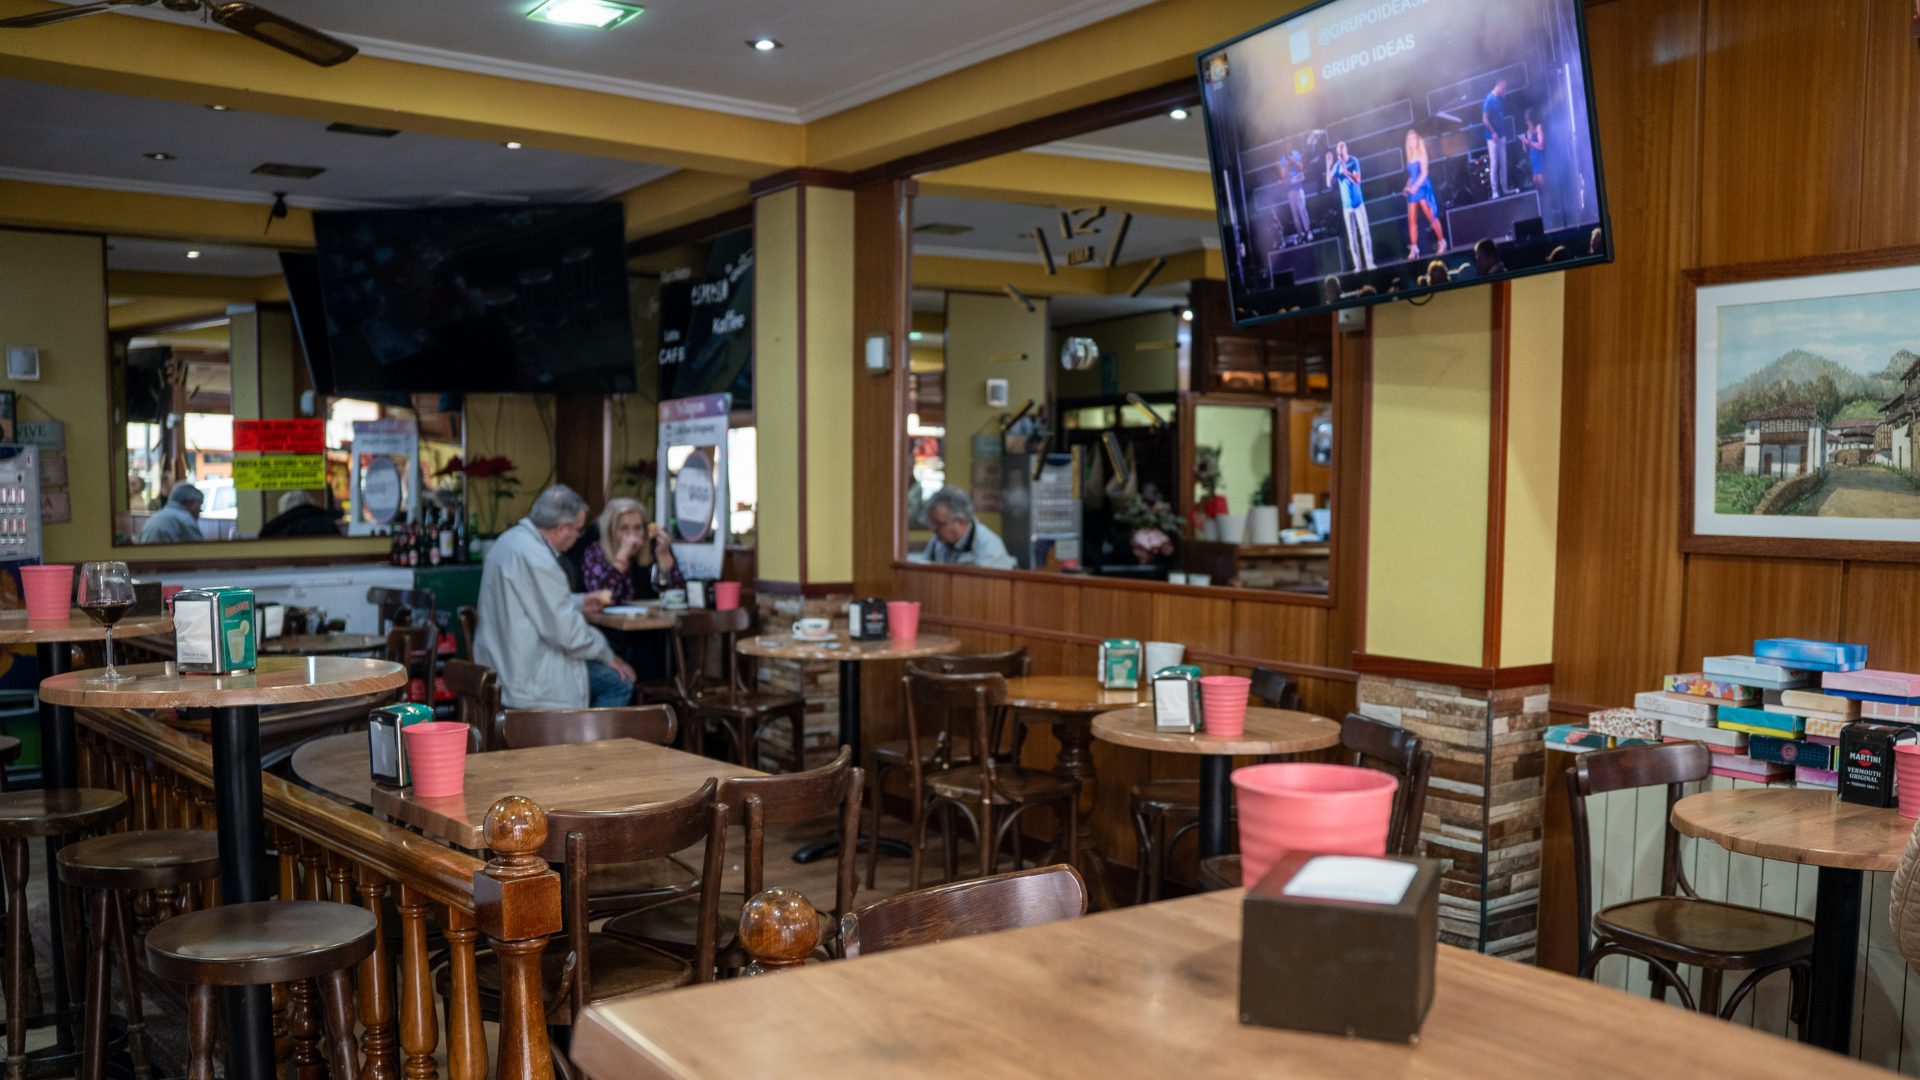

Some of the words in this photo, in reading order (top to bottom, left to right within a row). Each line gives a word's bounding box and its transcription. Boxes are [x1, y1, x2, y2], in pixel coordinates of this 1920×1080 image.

[1322, 51, 1370, 80] GRUPO
[1372, 34, 1416, 62] IDEAS
[1849, 752, 1881, 764] MARTINI
[1847, 766, 1881, 778] VERMOUTH
[1849, 773, 1878, 783] ORIGINAL
